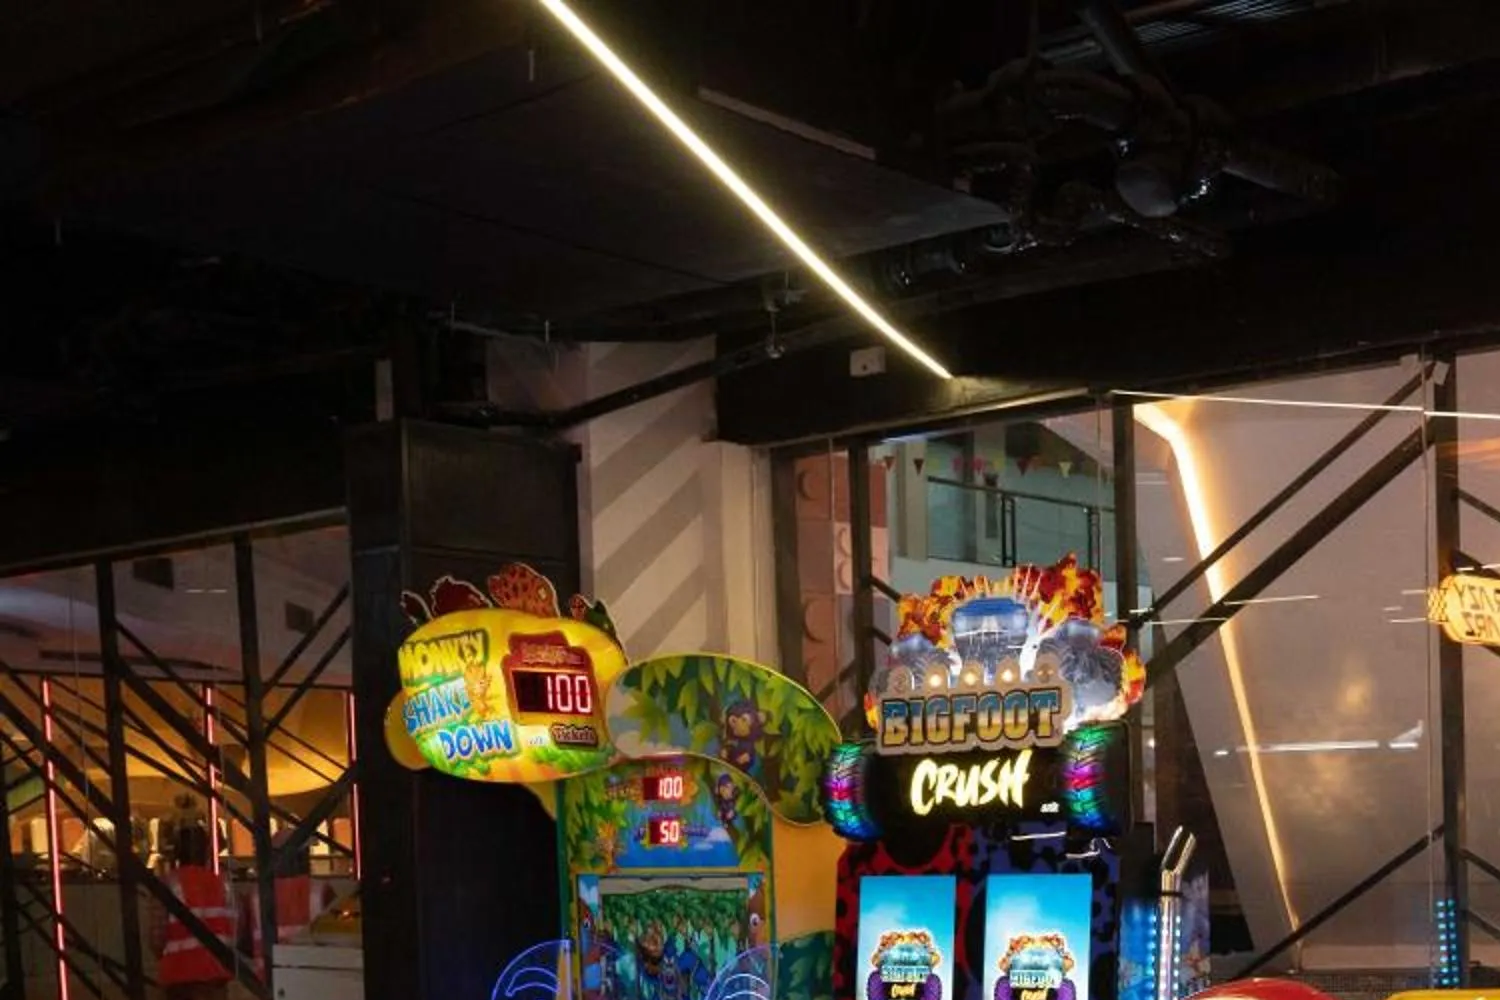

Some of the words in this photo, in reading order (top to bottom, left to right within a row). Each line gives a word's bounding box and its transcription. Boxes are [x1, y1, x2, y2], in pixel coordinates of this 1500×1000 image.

[547, 674, 592, 713] 100
[881, 688, 1062, 748] BIGFOOT
[437, 720, 513, 760] DOWN
[659, 775, 683, 799] 100
[911, 749, 1033, 816] CRUSH
[660, 820, 680, 843] 50
